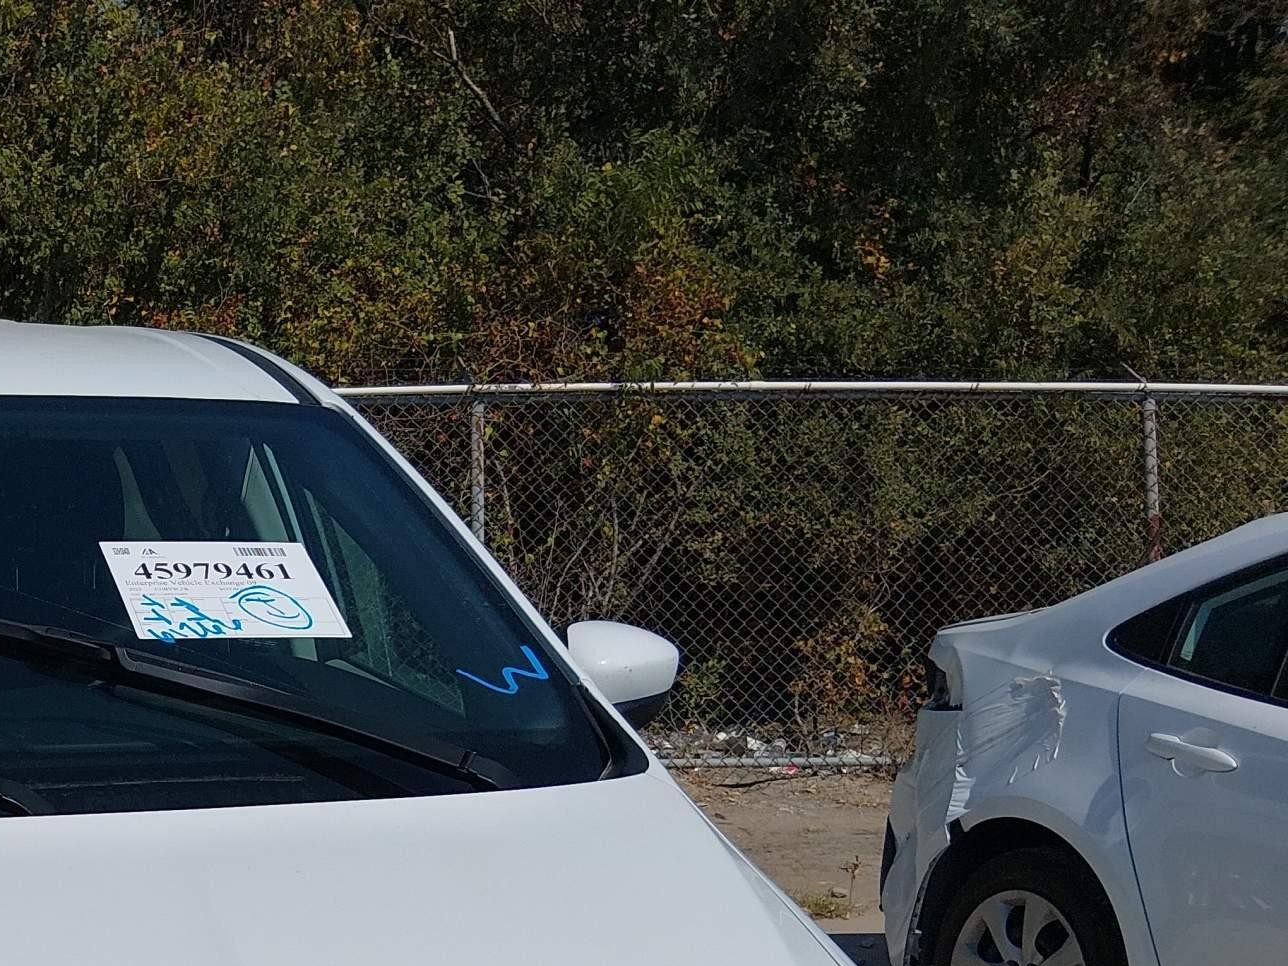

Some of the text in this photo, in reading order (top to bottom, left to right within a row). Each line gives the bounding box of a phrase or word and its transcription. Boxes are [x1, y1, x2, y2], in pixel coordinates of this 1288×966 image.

[134, 562, 292, 580] 45979461
[125, 579, 168, 587] Enterprise
[204, 579, 245, 587] Exchange
